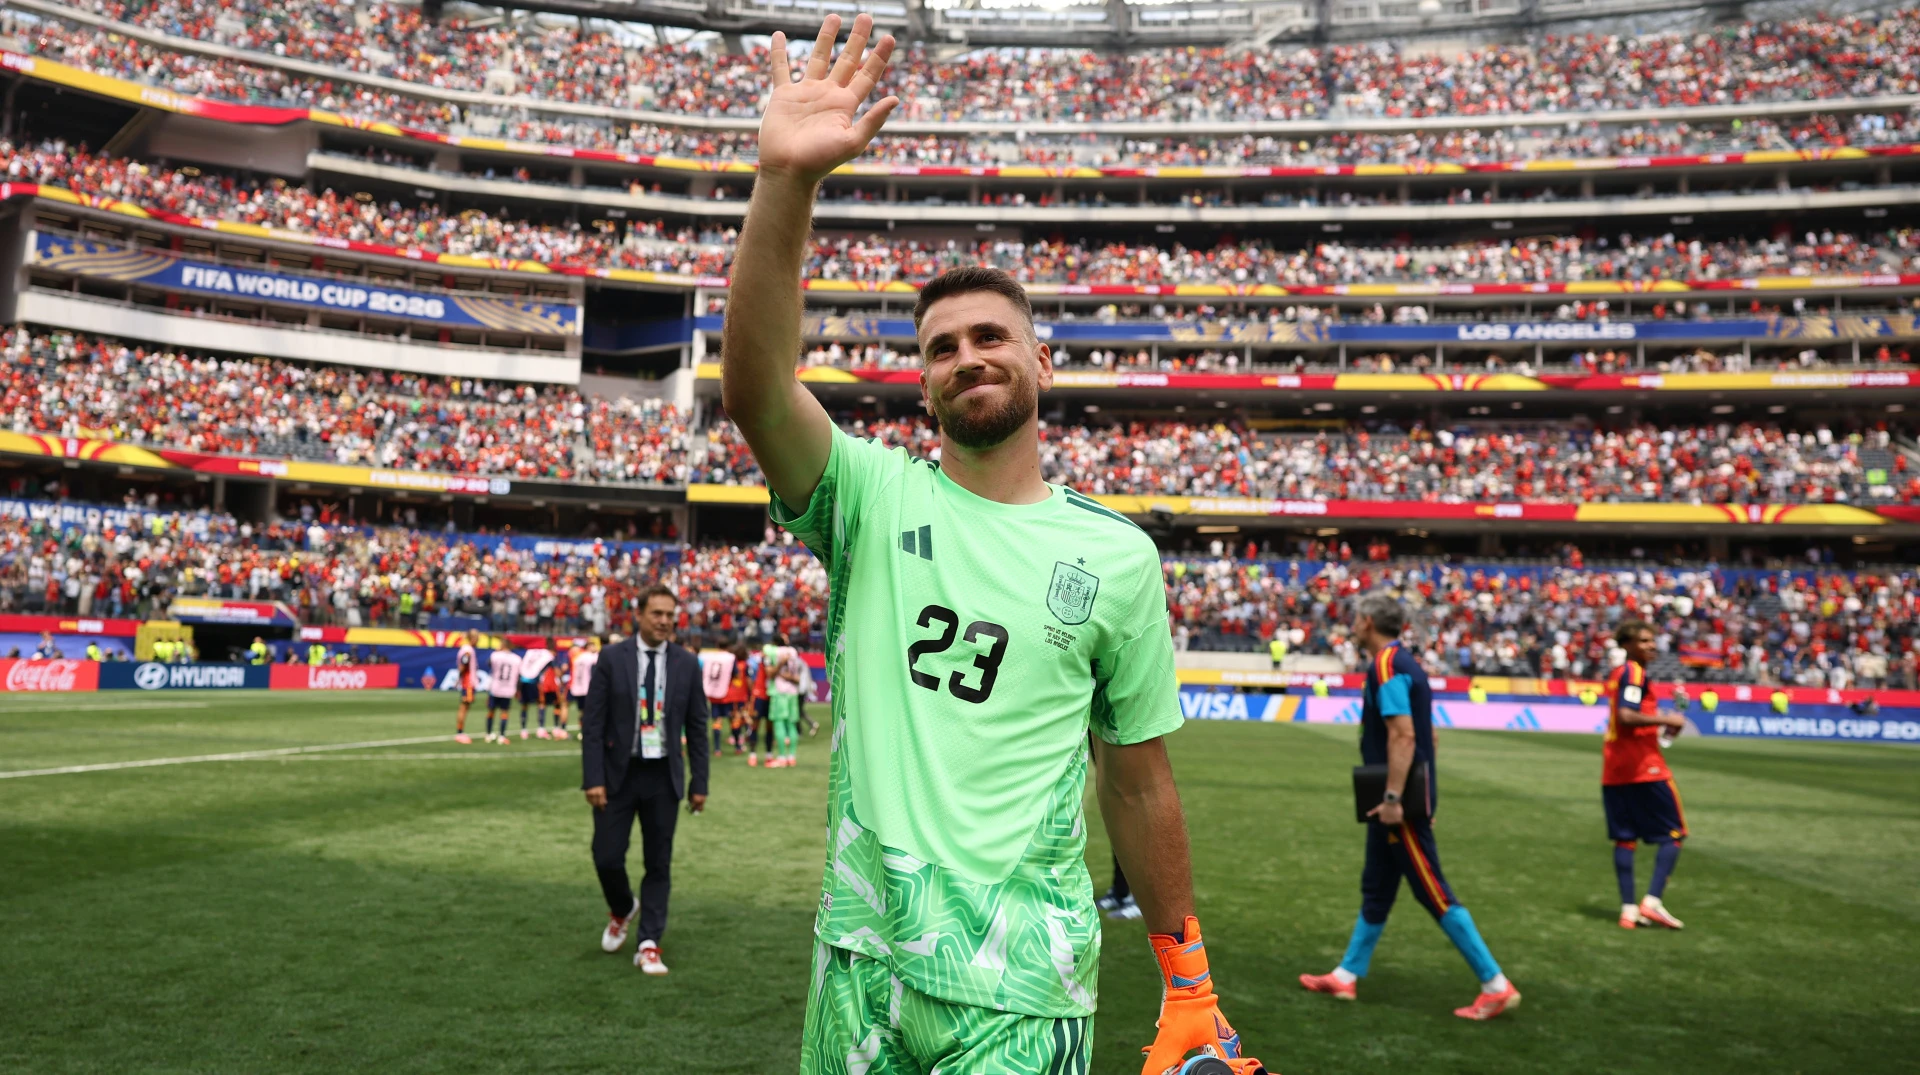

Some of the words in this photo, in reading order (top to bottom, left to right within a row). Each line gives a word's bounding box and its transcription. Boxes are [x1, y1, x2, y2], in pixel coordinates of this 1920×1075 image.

[181, 266, 234, 292] FIFA
[236, 272, 320, 303] WORLD
[321, 284, 367, 309] CUP
[368, 291, 445, 319] 2026
[1458, 324, 1511, 340] LOS
[1513, 323, 1636, 339] ANGELES
[907, 604, 1009, 704] 23
[170, 666, 245, 687] HYUNDAI
[308, 666, 367, 688] Lenovo
[1180, 691, 1248, 719] VISA
[1714, 714, 1760, 735] FIFA
[1761, 716, 1836, 738] WORLD
[1837, 718, 1881, 739] CUP
